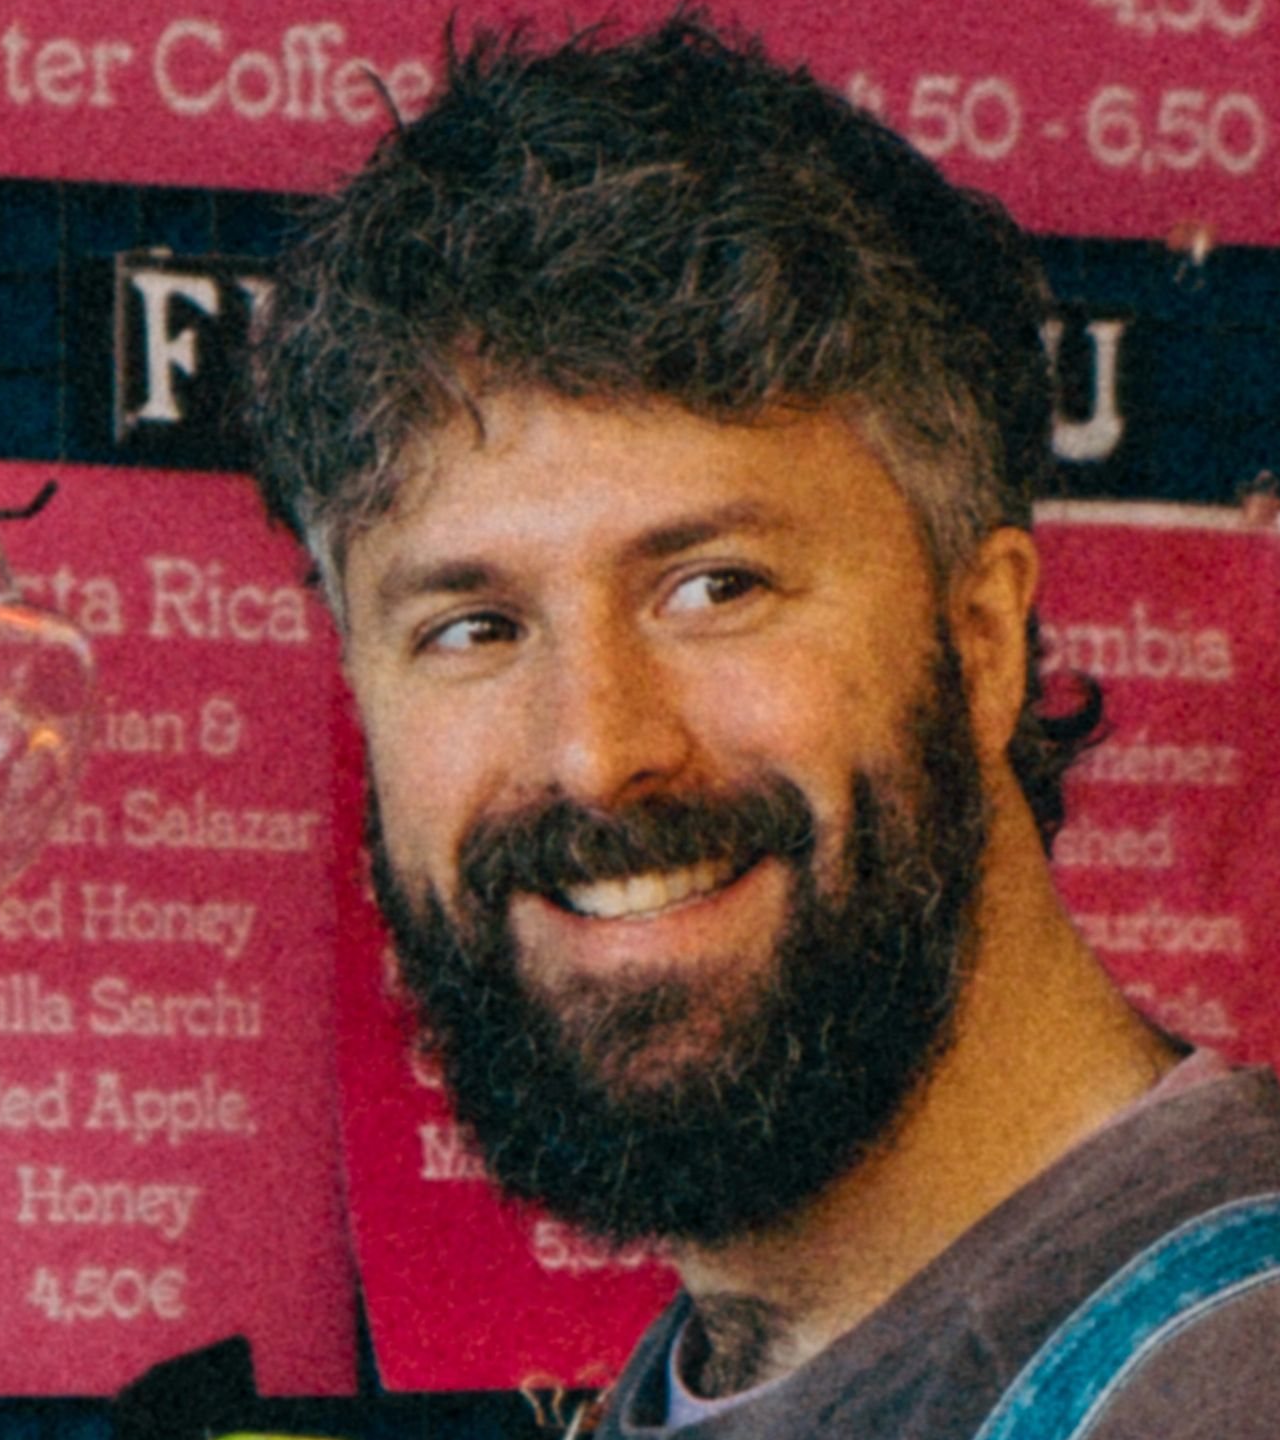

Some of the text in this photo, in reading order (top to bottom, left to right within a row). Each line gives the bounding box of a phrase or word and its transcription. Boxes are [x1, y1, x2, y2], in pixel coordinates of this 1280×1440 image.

[153, 18, 436, 127] Coffee
[847, 71, 1020, 161] 50
[1086, 85, 1266, 175] 6,50
[146, 554, 312, 643] Rica
[123, 789, 322, 851] Salazar
[80, 881, 261, 960] Honey
[90, 976, 264, 1039] Sarchi
[17, 1165, 202, 1241] Honey
[25, 1264, 191, 1325] 4,50€
